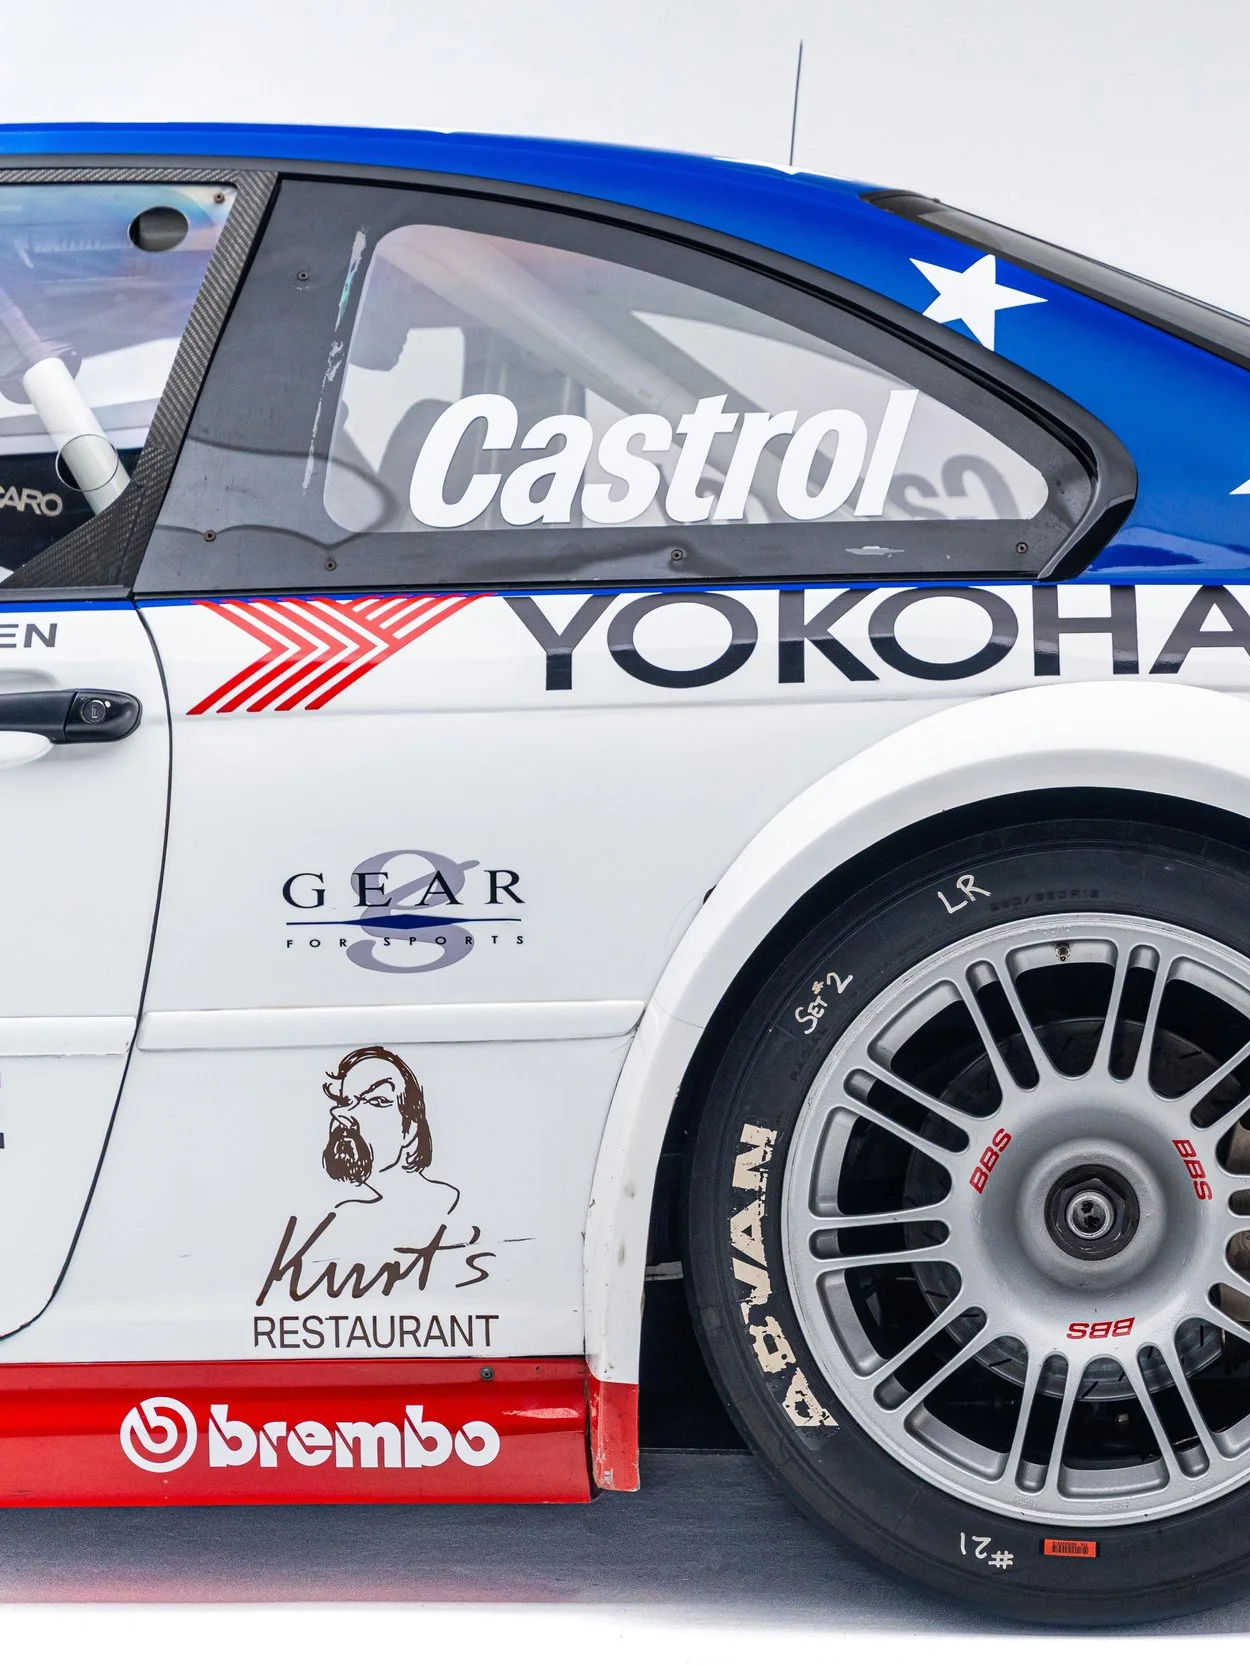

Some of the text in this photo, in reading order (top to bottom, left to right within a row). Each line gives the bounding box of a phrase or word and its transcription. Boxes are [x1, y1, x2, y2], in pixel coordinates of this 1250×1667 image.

[408, 389, 920, 529] Castrol
[282, 869, 526, 909] GEAR
[936, 873, 992, 914] LR
[286, 935, 524, 949] FOR SPORTS
[969, 1128, 1012, 1195] BBS
[1173, 1139, 1213, 1202] BBS
[255, 1212, 496, 1306] Kurt's
[729, 1123, 841, 1428] ADVAN
[253, 1314, 499, 1348] RESTAURANT
[1066, 1317, 1136, 1340] BBS
[209, 1404, 501, 1468] brembo
